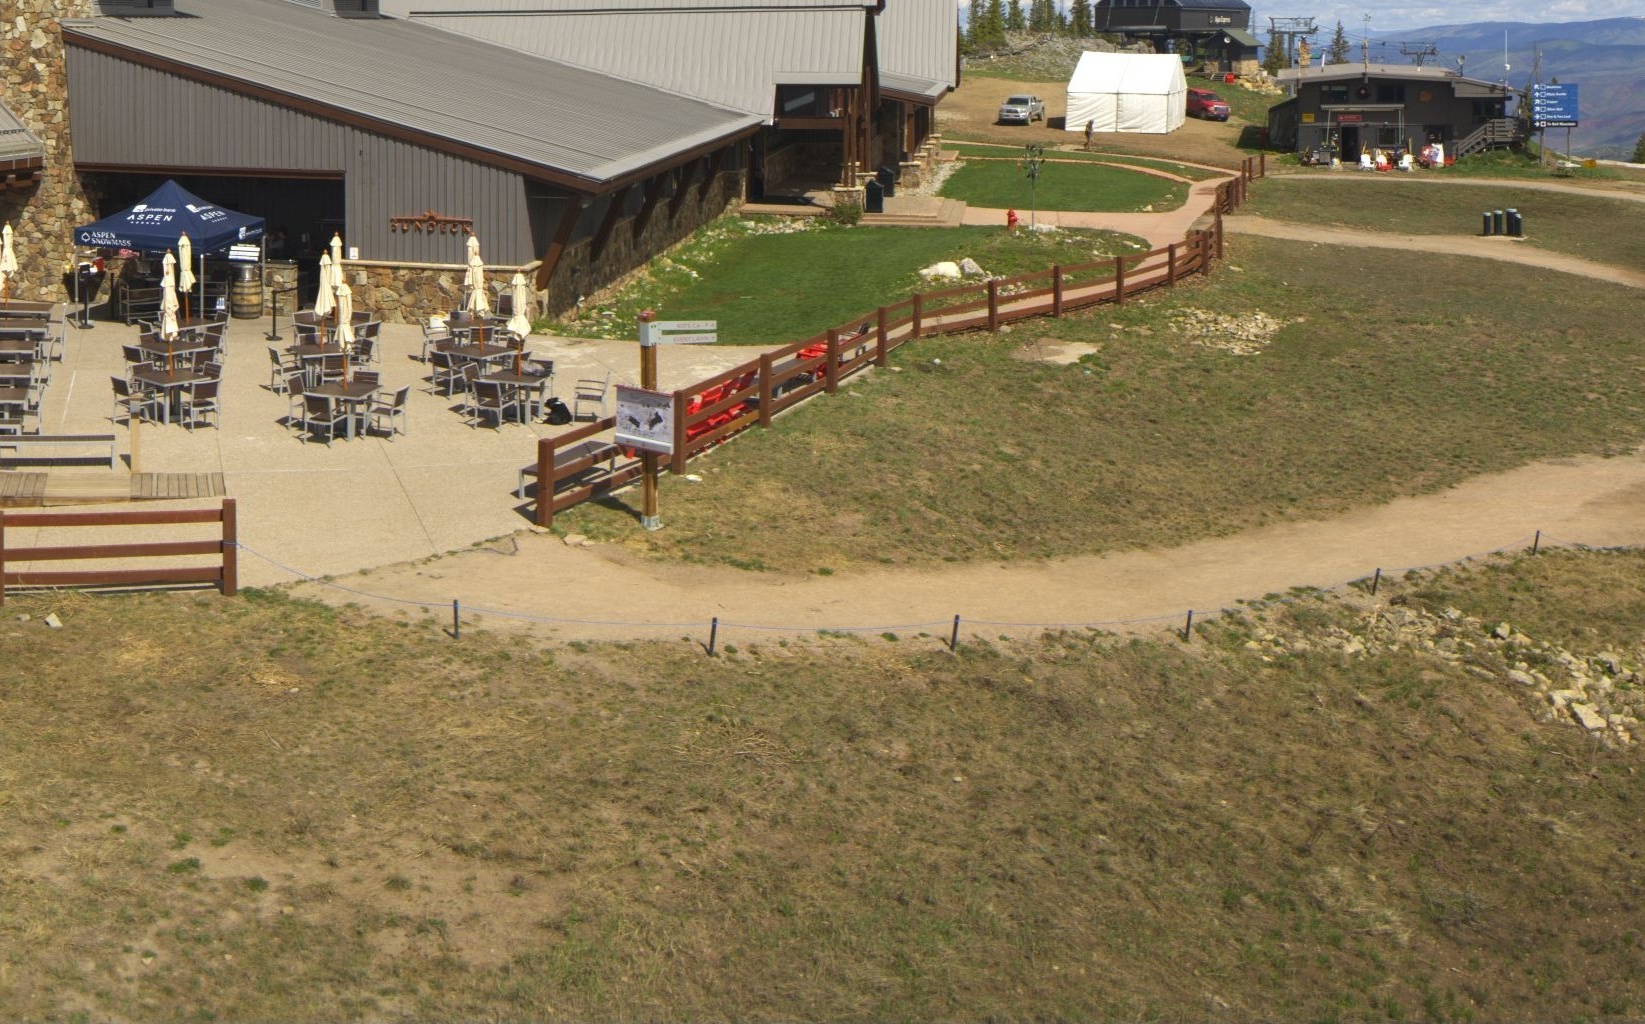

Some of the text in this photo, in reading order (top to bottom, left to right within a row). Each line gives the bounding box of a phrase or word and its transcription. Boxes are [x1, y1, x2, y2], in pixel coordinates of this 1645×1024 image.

[126, 214, 173, 222] ASPEN
[199, 210, 227, 221] ASPEN
[91, 231, 116, 239] ASPEN
[91, 238, 132, 247] SNOWMASS
